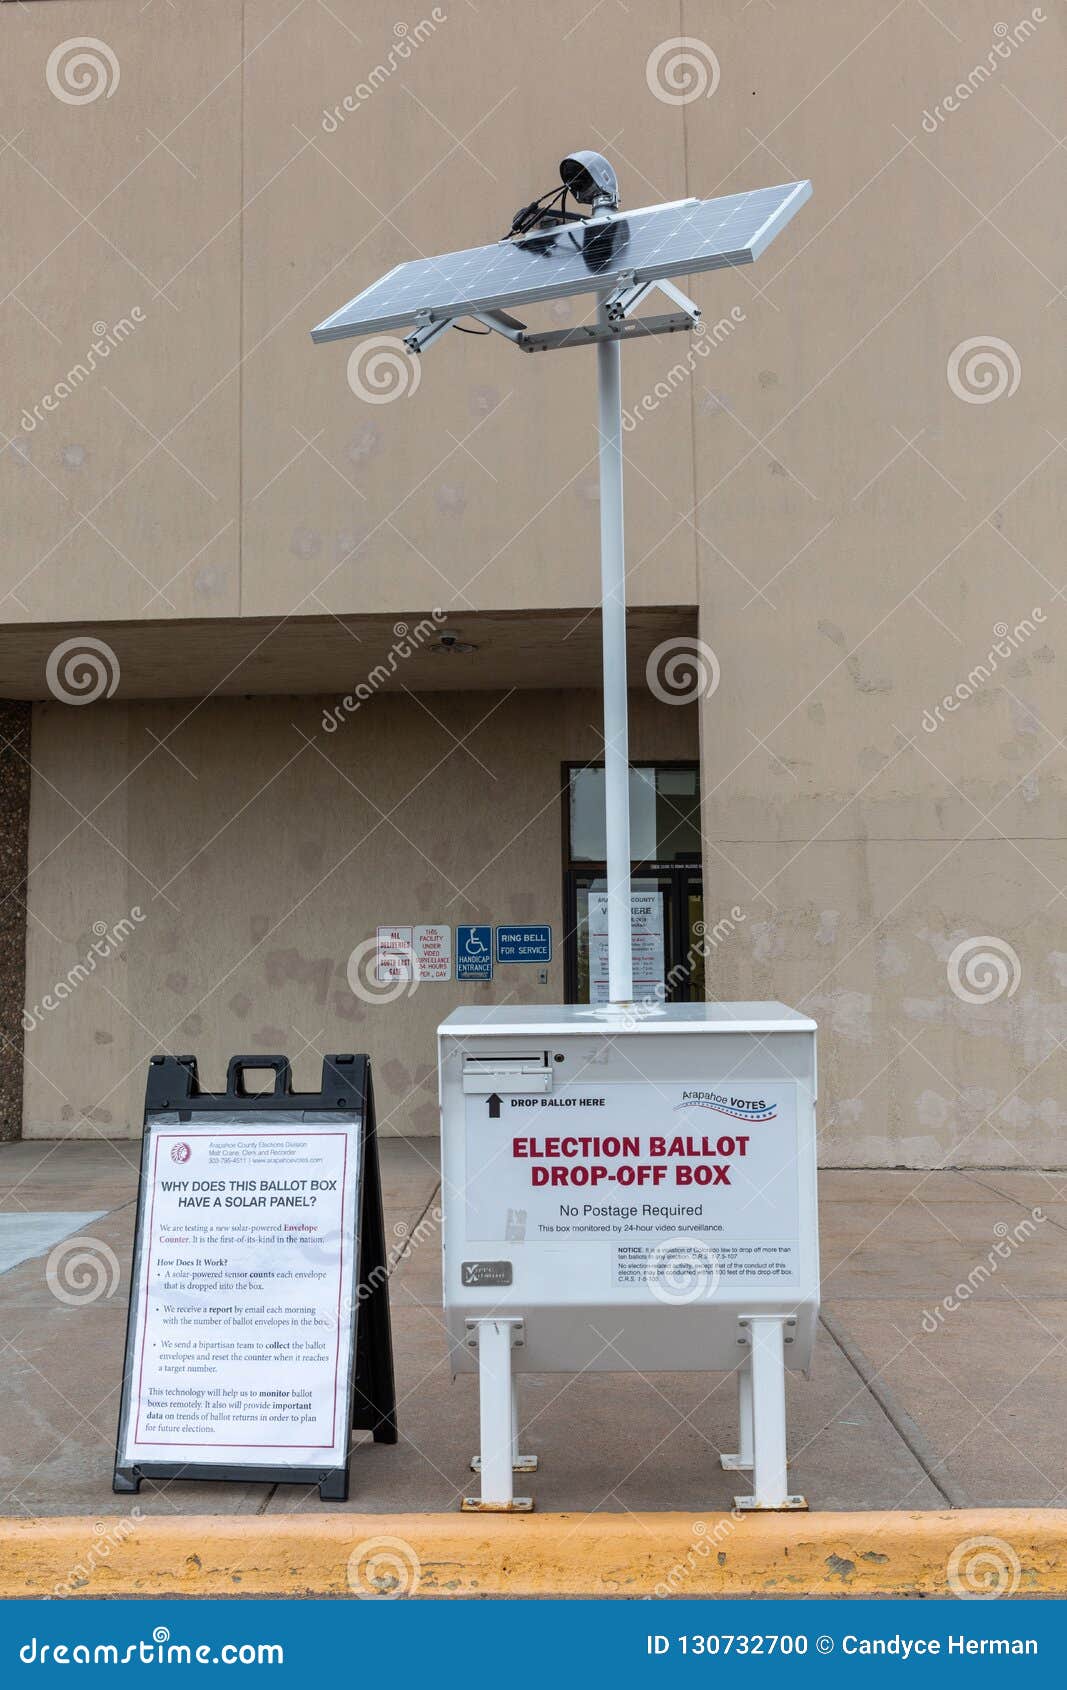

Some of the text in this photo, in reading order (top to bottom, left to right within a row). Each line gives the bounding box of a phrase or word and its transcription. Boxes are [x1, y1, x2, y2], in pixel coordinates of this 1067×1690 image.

[501, 934, 546, 943] RING BELL
[501, 946, 547, 954] FOR SERVICE
[458, 964, 491, 972] ENTRANCE
[511, 1099, 538, 1107] DROP
[541, 1099, 578, 1107] BALLOT
[683, 1091, 766, 1110] Arapahoe VOTES
[512, 1136, 750, 1157] ELECTION BALLOT
[532, 1165, 731, 1186] DROP-OFF BOX
[162, 1180, 337, 1191] WHY DOES THIS BALLOT BOX
[178, 1197, 317, 1207] HAVE A SOLAR PANEL?
[560, 1204, 703, 1218] No Postage Required
[185, 1224, 207, 1233] testing
[231, 1224, 282, 1233] solar-powered
[284, 1224, 318, 1233] Envelope
[613, 1225, 622, 1233] by
[655, 1224, 676, 1232] video
[678, 1224, 725, 1232] surveillance.
[172, 1271, 223, 1280] solar-powered
[294, 1271, 327, 1280] envelope
[187, 1282, 218, 1292] dropped
[209, 1306, 233, 1315] report
[285, 1306, 316, 1316] morning
[254, 1318, 289, 1327] envelopes
[199, 1341, 234, 1351] bipartisan
[305, 1342, 326, 1350] ballot
[159, 1353, 194, 1362] envelopes
[244, 1353, 272, 1361] counter
[273, 1353, 294, 1361] when
[164, 1364, 185, 1374] target
[165, 1389, 206, 1398] technology
[222, 1390, 238, 1399] help
[169, 1401, 203, 1410] remotely.
[243, 1402, 271, 1411] provide
[272, 1402, 312, 1411] important
[232, 1413, 258, 1421] returns
[300, 1414, 317, 1424] plan
